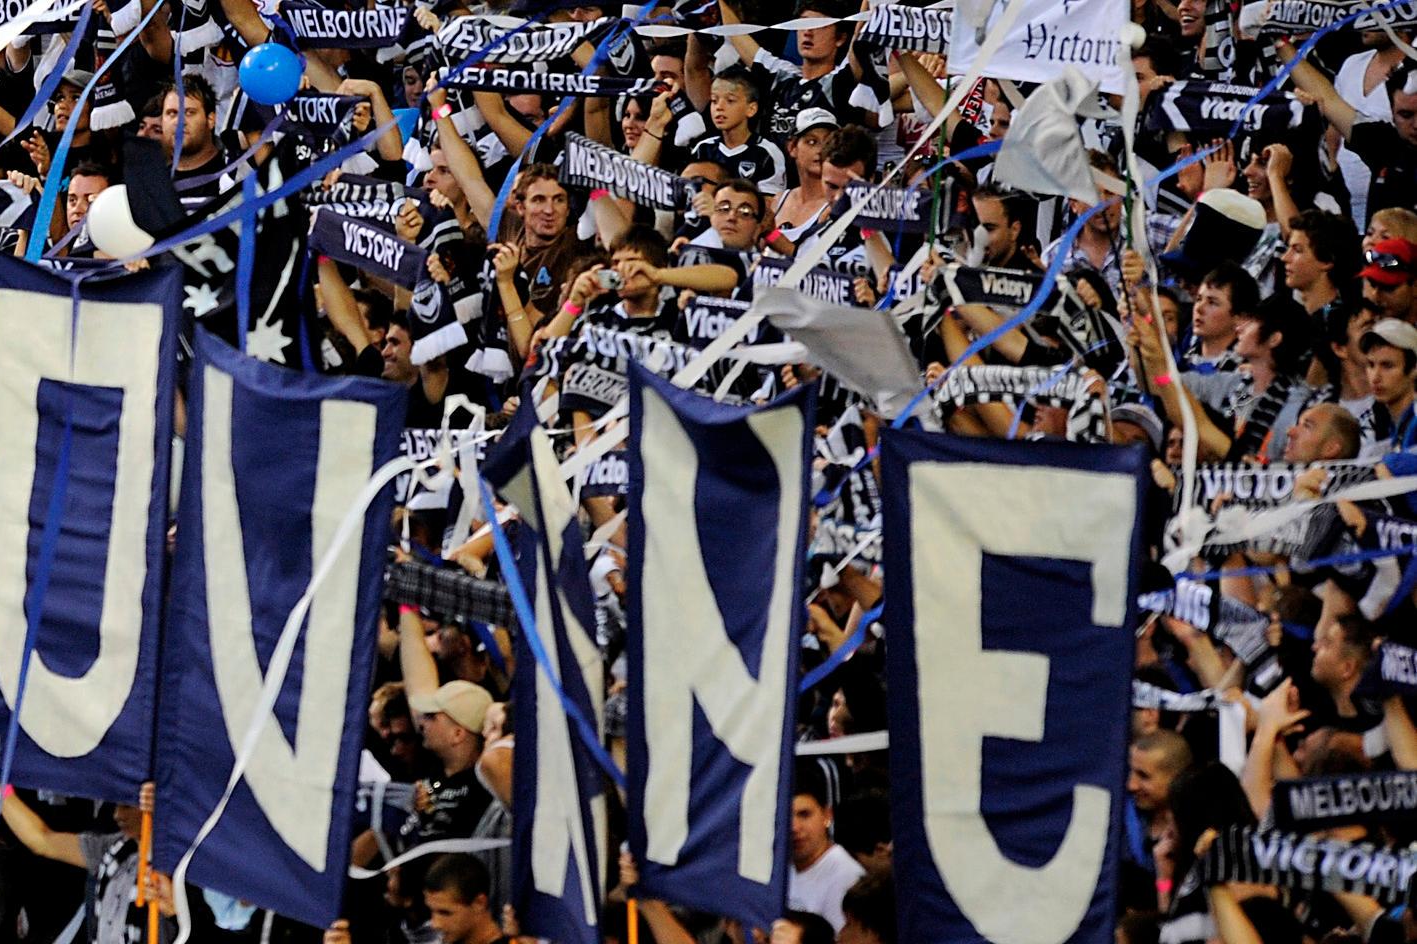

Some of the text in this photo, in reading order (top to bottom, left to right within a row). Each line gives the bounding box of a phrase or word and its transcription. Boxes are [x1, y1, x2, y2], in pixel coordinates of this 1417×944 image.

[287, 8, 408, 38] MELBOURNE
[569, 141, 674, 206] MELBOURNE
[342, 220, 405, 272] VICTORY
